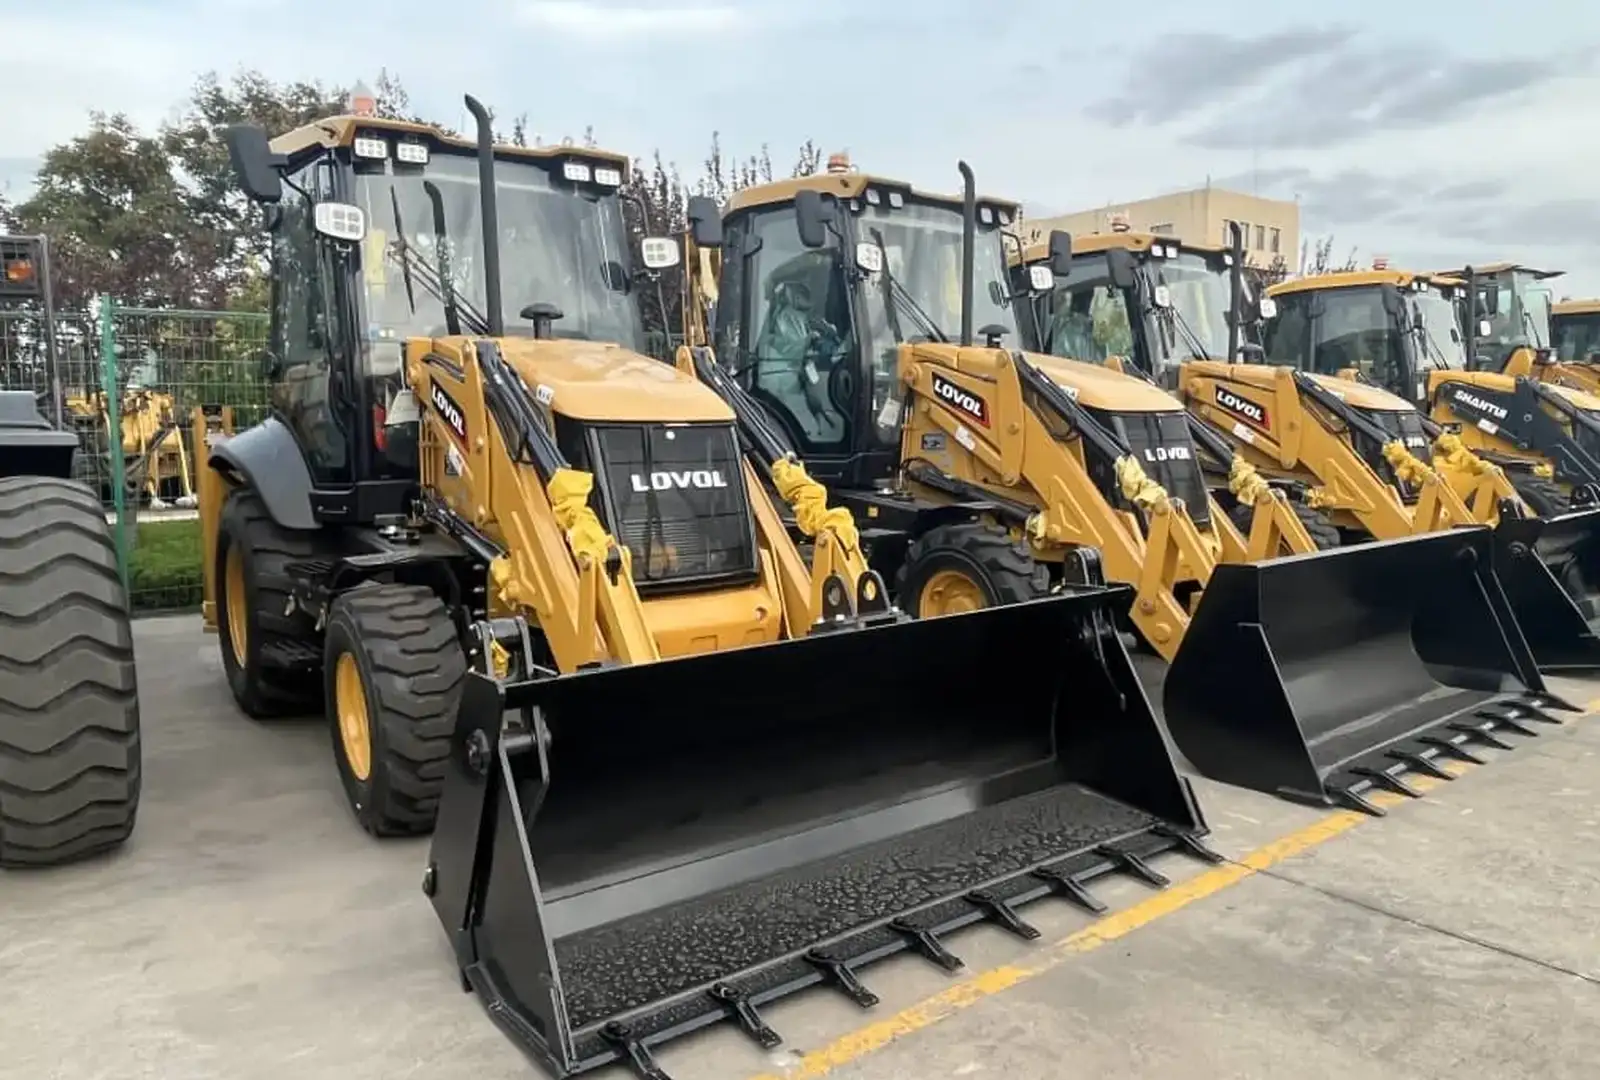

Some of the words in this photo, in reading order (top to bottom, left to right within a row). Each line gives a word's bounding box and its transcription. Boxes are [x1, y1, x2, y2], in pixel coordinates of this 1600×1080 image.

[432, 383, 465, 436] LOVOL
[934, 378, 982, 417] LOVOL
[1217, 390, 1262, 421] LOVOL
[1143, 447, 1191, 461] LOVOL
[630, 470, 728, 492] LOVOL
